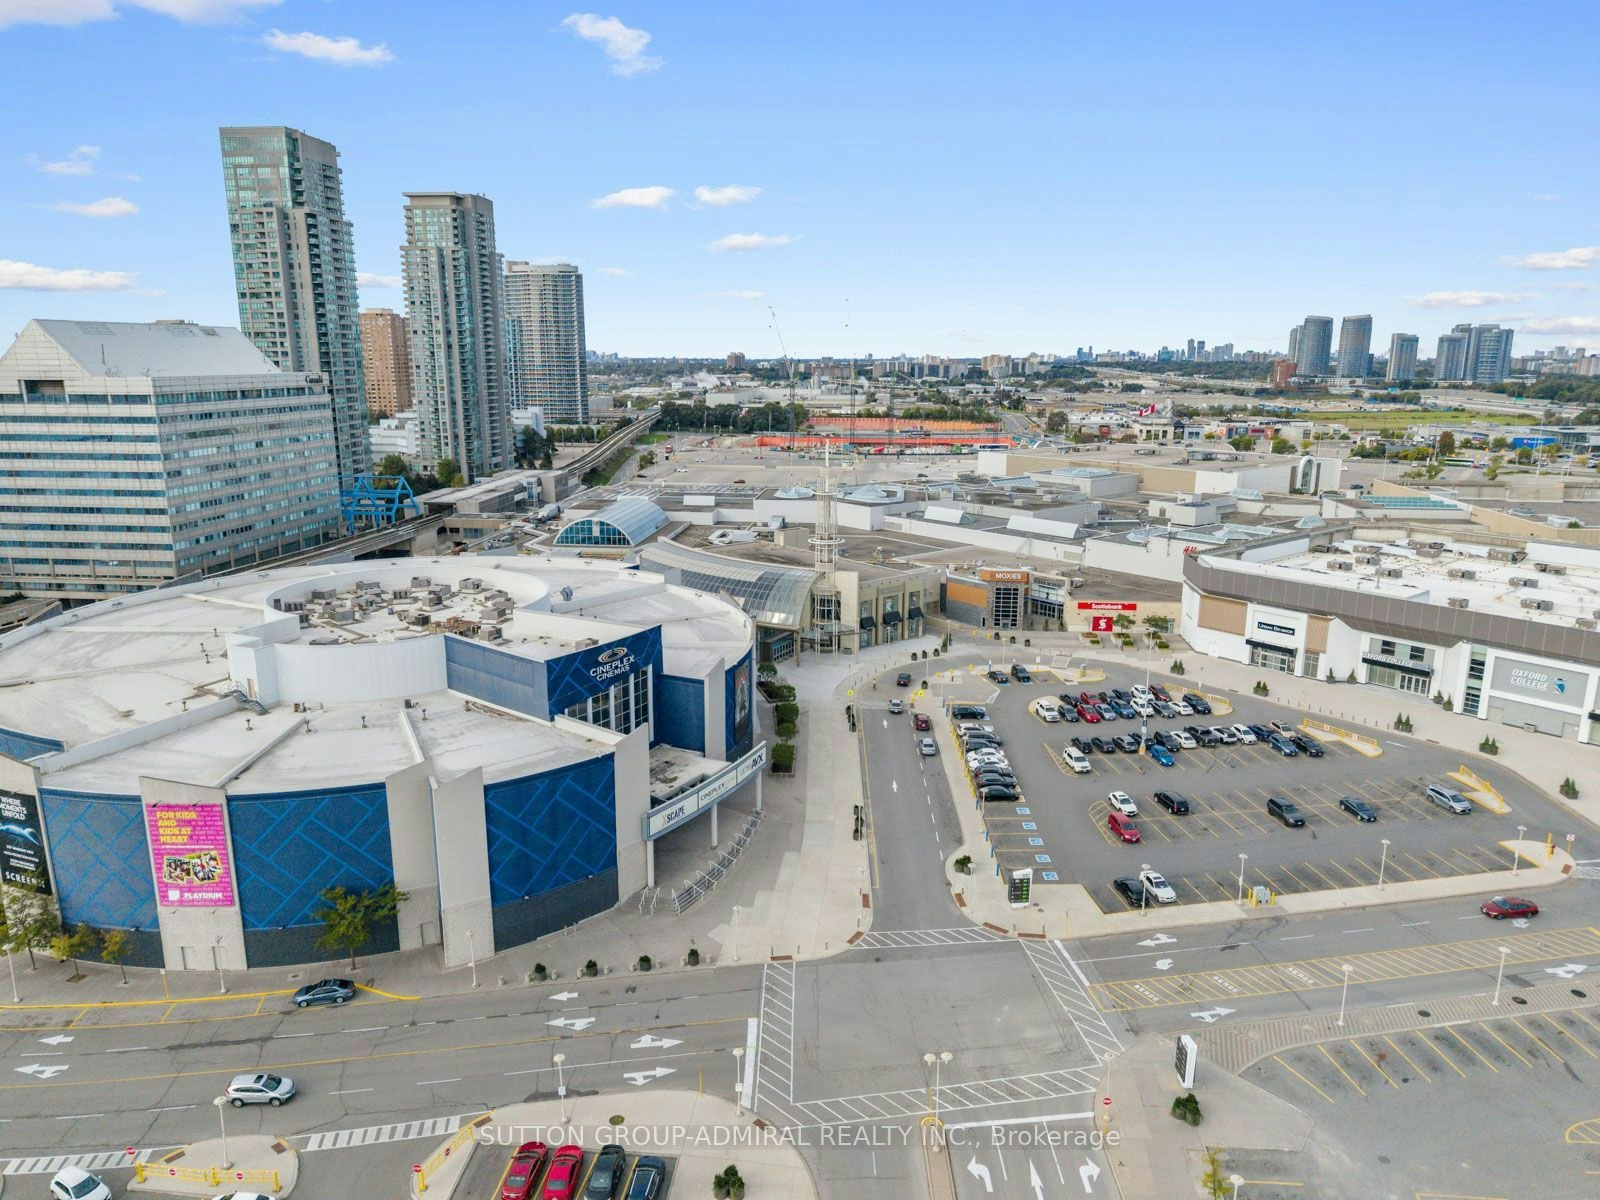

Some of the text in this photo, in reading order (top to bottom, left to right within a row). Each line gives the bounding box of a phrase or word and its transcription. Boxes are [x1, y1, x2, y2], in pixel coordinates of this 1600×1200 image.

[590, 655, 635, 677] CINEPLEX
[596, 665, 630, 681] CINEMAS
[1512, 668, 1547, 682] OXFORD
[1511, 676, 1551, 690] COLLEGE
[0, 796, 22, 807] WHERE
[1, 809, 26, 821] UNFOLD
[157, 811, 197, 819] FOR KIDS
[158, 819, 177, 827] AND
[159, 827, 192, 835] KIDS AT
[160, 835, 189, 843] HEART
